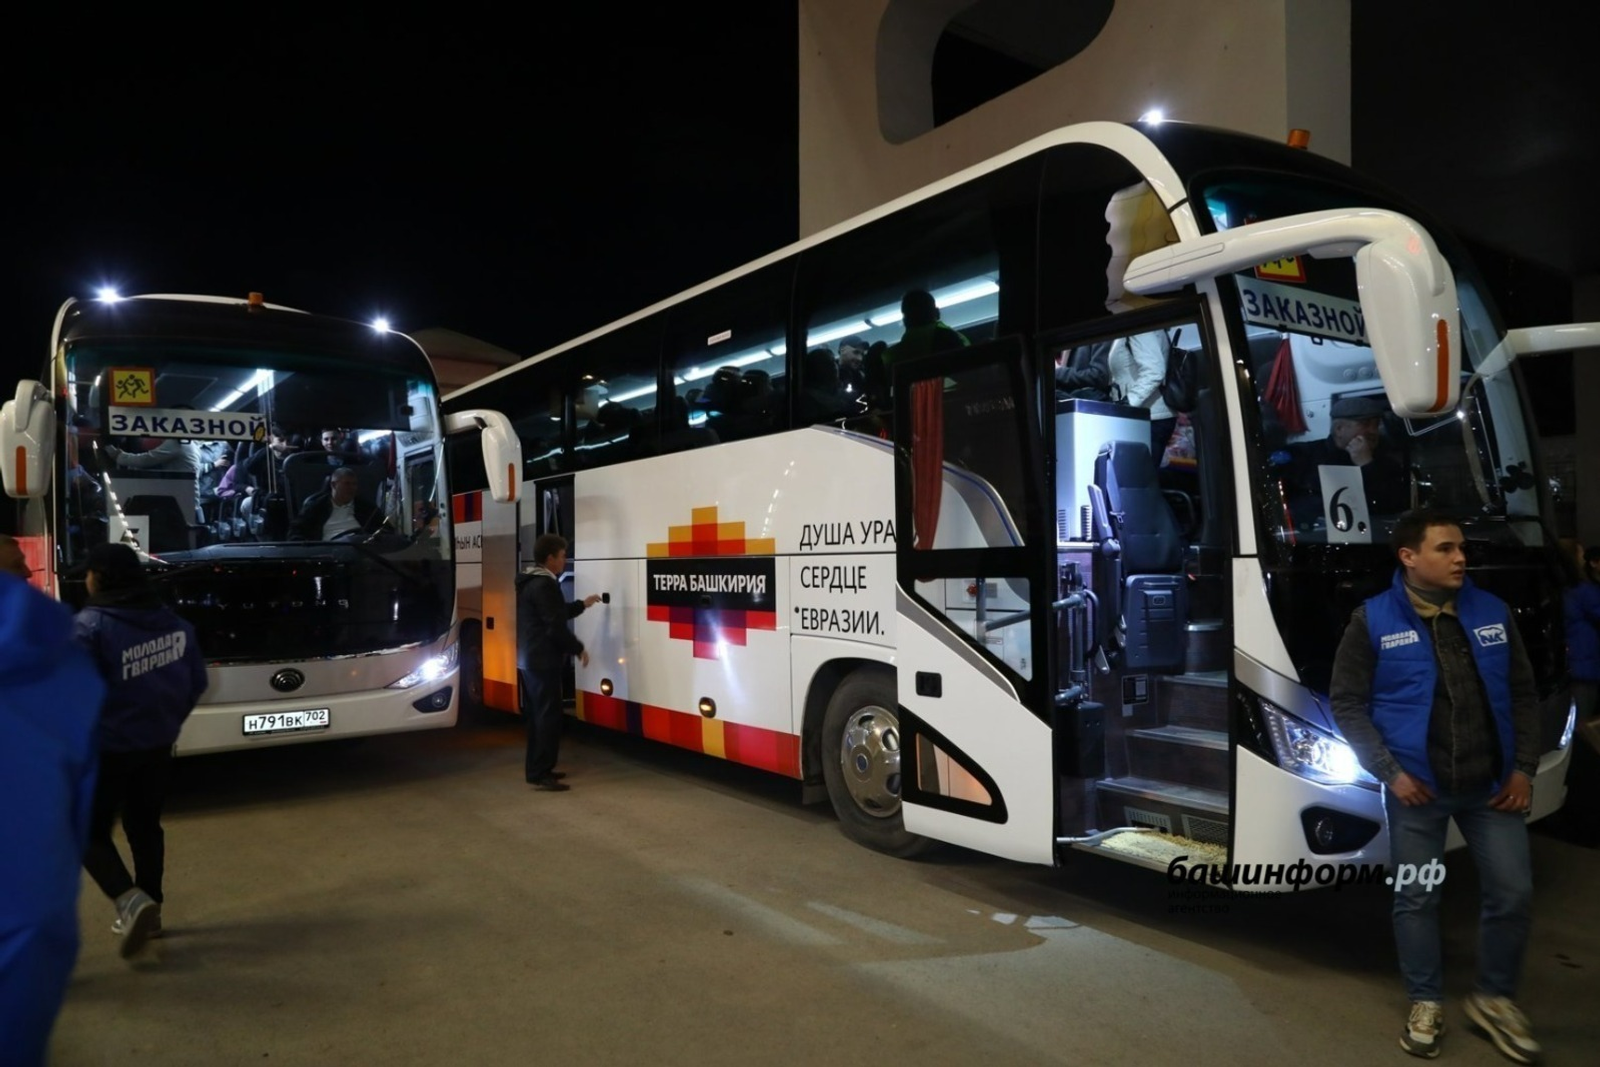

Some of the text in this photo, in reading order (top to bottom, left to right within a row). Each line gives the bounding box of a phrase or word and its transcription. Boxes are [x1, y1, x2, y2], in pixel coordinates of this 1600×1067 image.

[1243, 289, 1366, 337] ЗАКАЗНОЙ
[1329, 486, 1367, 533] 6.
[799, 519, 897, 551] ДУША УРА
[653, 574, 766, 593] ТЕРРА БАШКИРИЯ
[800, 566, 867, 594] СЕРДЦЕ
